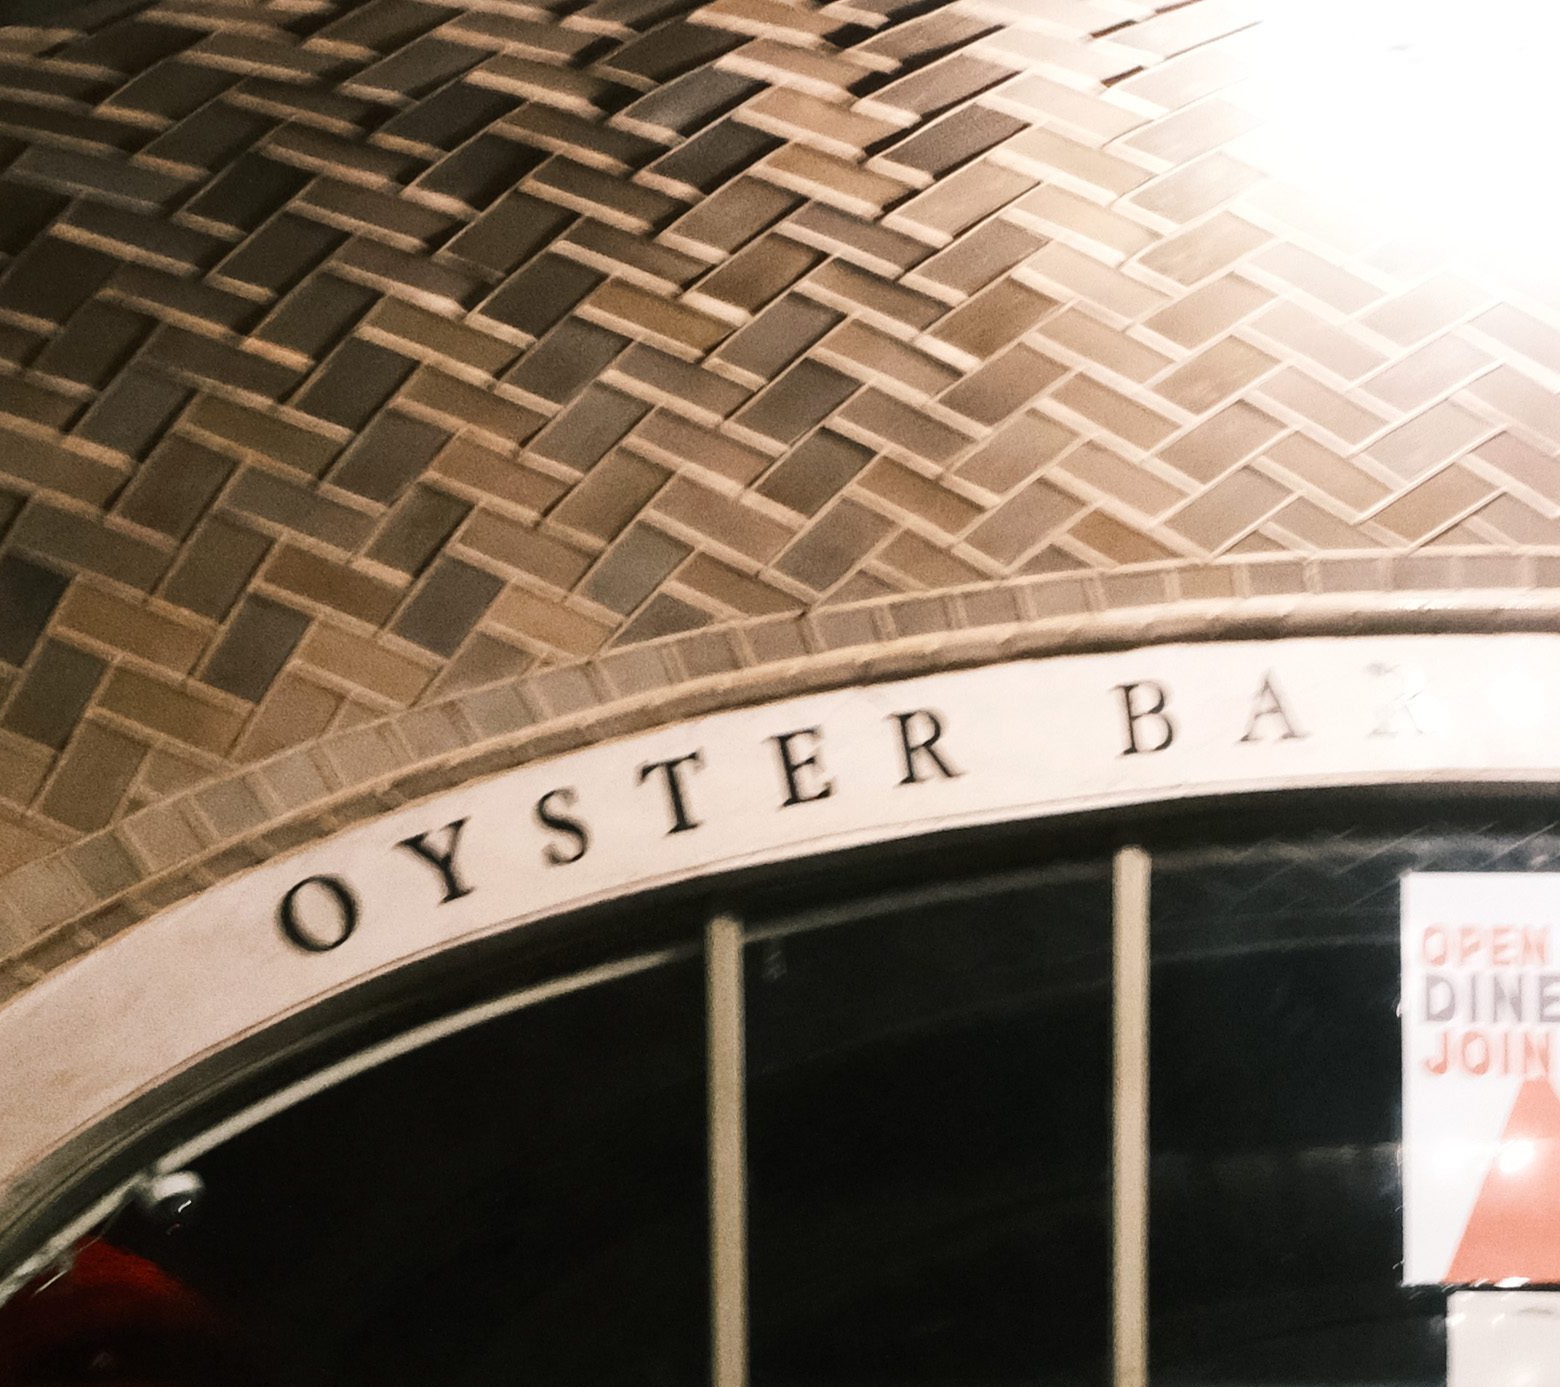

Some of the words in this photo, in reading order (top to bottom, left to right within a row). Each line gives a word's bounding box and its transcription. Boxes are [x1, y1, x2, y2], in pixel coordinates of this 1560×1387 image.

[275, 707, 964, 954] OYSTER
[1421, 925, 1551, 966] OPEN
[1422, 1030, 1552, 1076] JOIN
